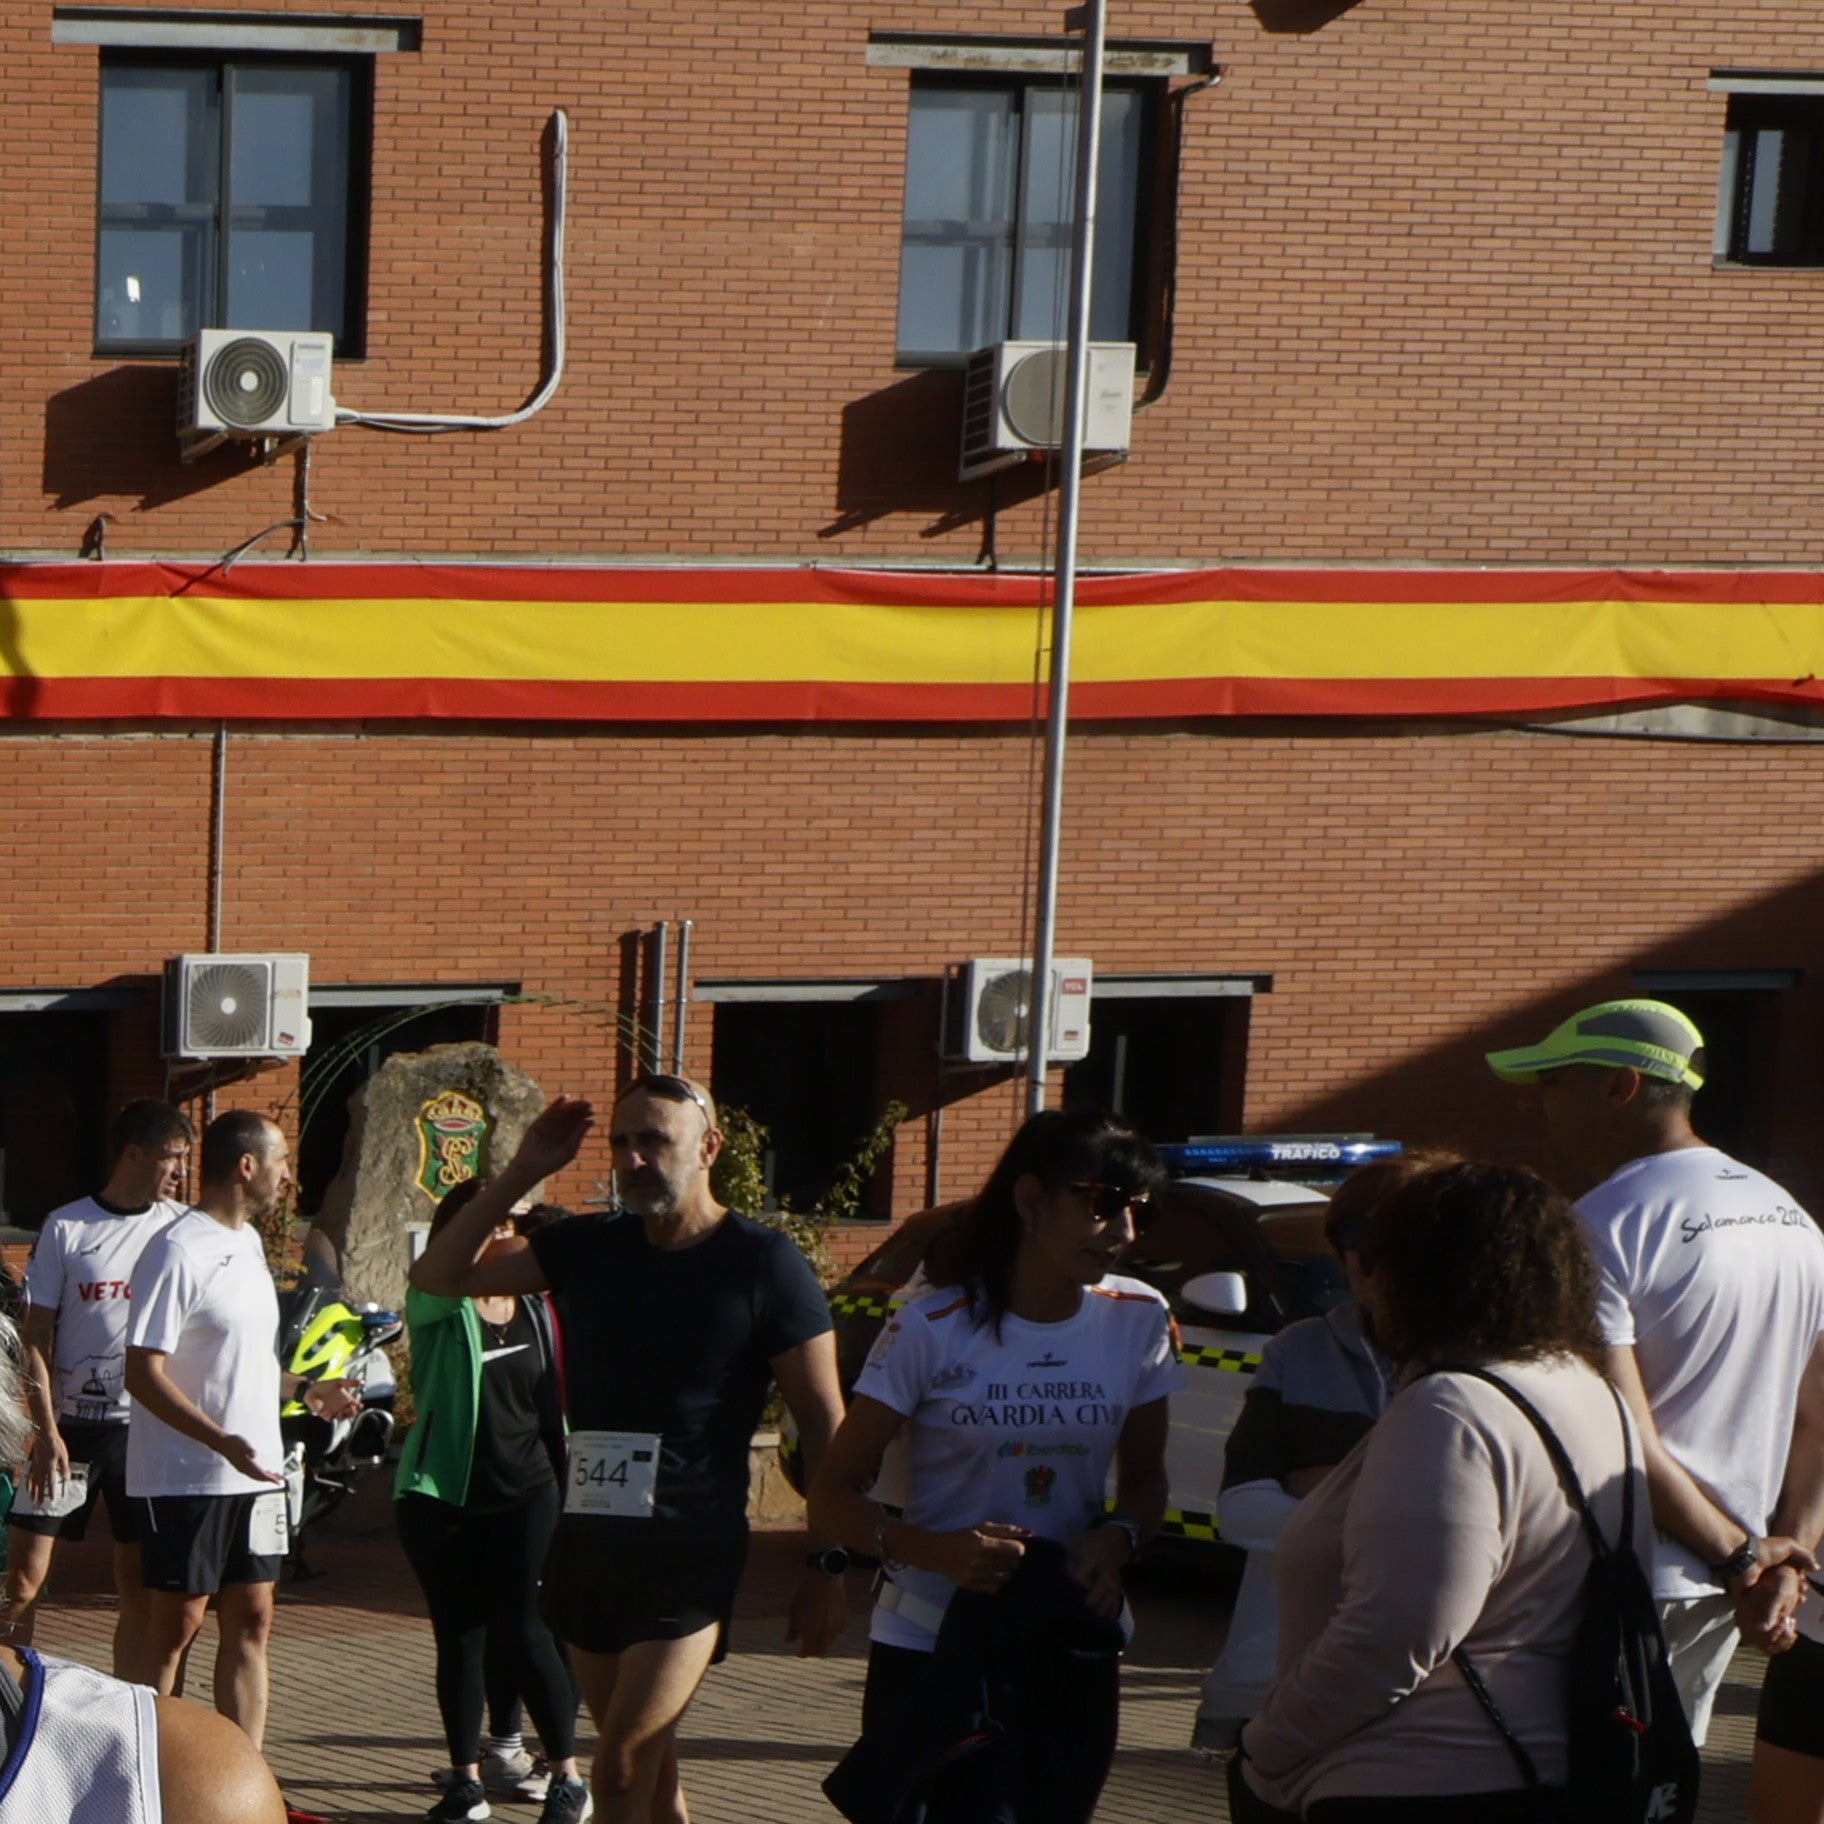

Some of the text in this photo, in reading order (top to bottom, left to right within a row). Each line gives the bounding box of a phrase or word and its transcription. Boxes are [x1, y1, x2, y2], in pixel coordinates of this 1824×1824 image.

[1680, 1212, 1776, 1243] Salamanca
[987, 1380, 1106, 1400] III CARRERA
[576, 1458, 629, 1488] 544
